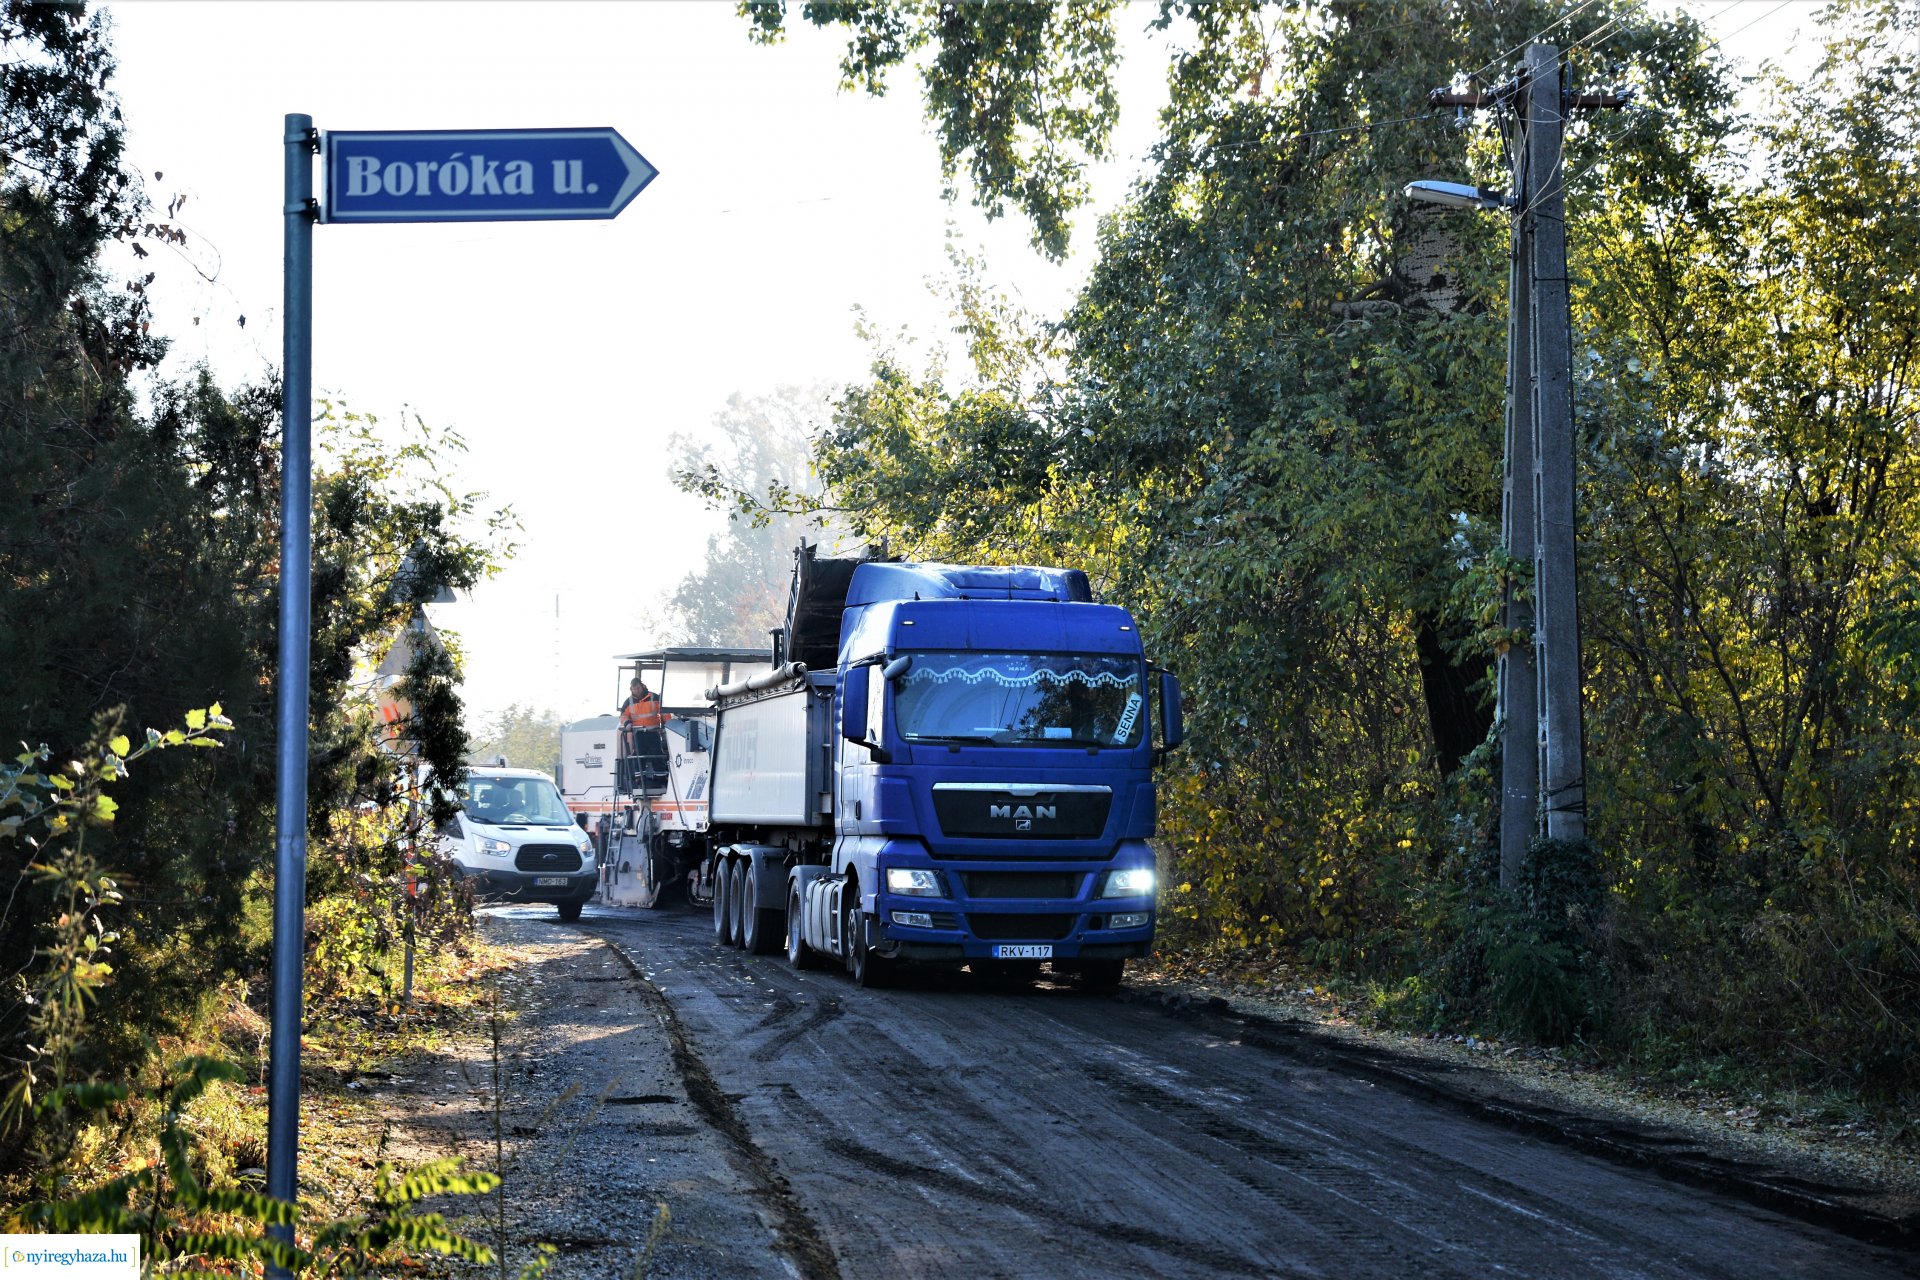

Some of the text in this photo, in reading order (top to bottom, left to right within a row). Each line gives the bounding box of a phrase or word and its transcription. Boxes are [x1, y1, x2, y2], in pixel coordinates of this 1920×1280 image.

[346, 152, 599, 196] Boróka u.
[1117, 699, 1141, 738] SENNA
[990, 805, 1057, 819] MAN
[1001, 946, 1050, 957] RKV-117
